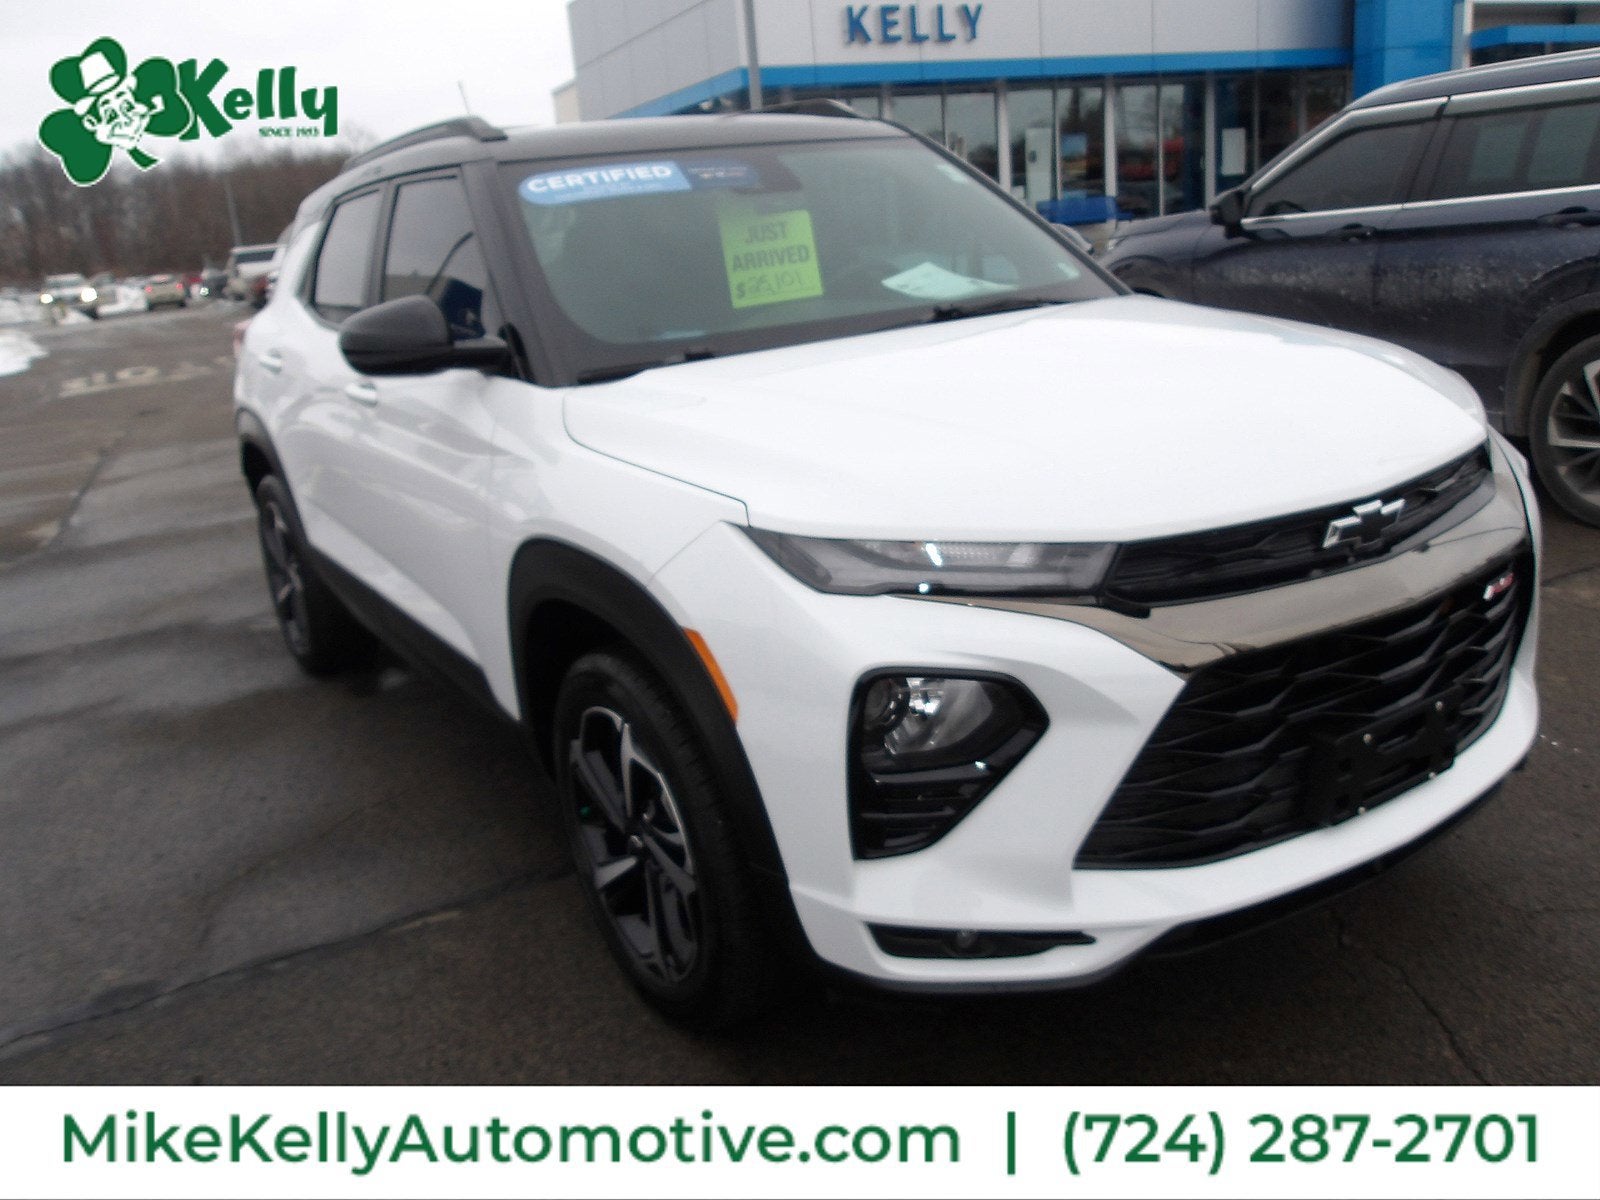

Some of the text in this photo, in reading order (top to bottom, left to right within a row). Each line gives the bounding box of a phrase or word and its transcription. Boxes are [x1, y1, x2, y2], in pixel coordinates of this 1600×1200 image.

[846, 4, 982, 44] KELLY
[526, 164, 673, 193] CERTIFIED
[745, 221, 788, 244] JUST
[732, 244, 810, 272] ARRIVED
